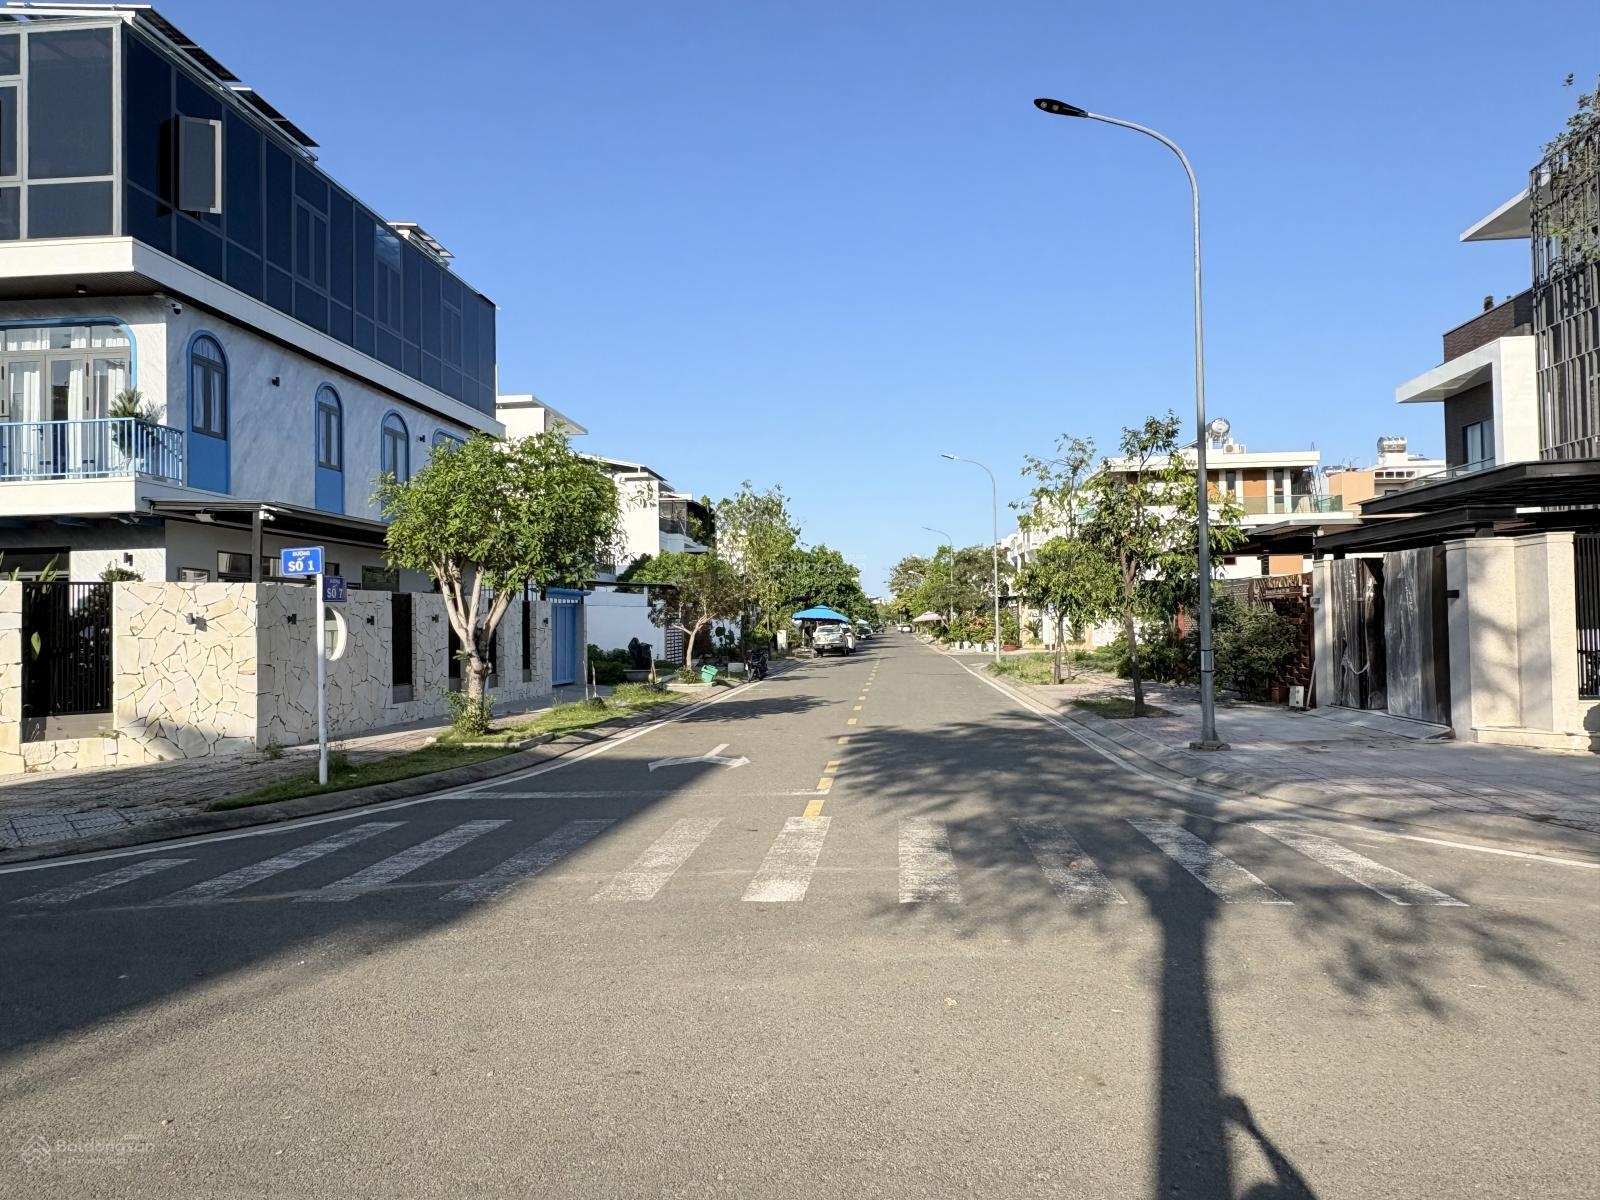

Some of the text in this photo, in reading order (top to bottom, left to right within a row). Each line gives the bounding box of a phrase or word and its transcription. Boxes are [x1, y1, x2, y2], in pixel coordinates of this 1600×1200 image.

[288, 557, 314, 571] SỐ 1
[327, 585, 343, 598] SỐ 7
